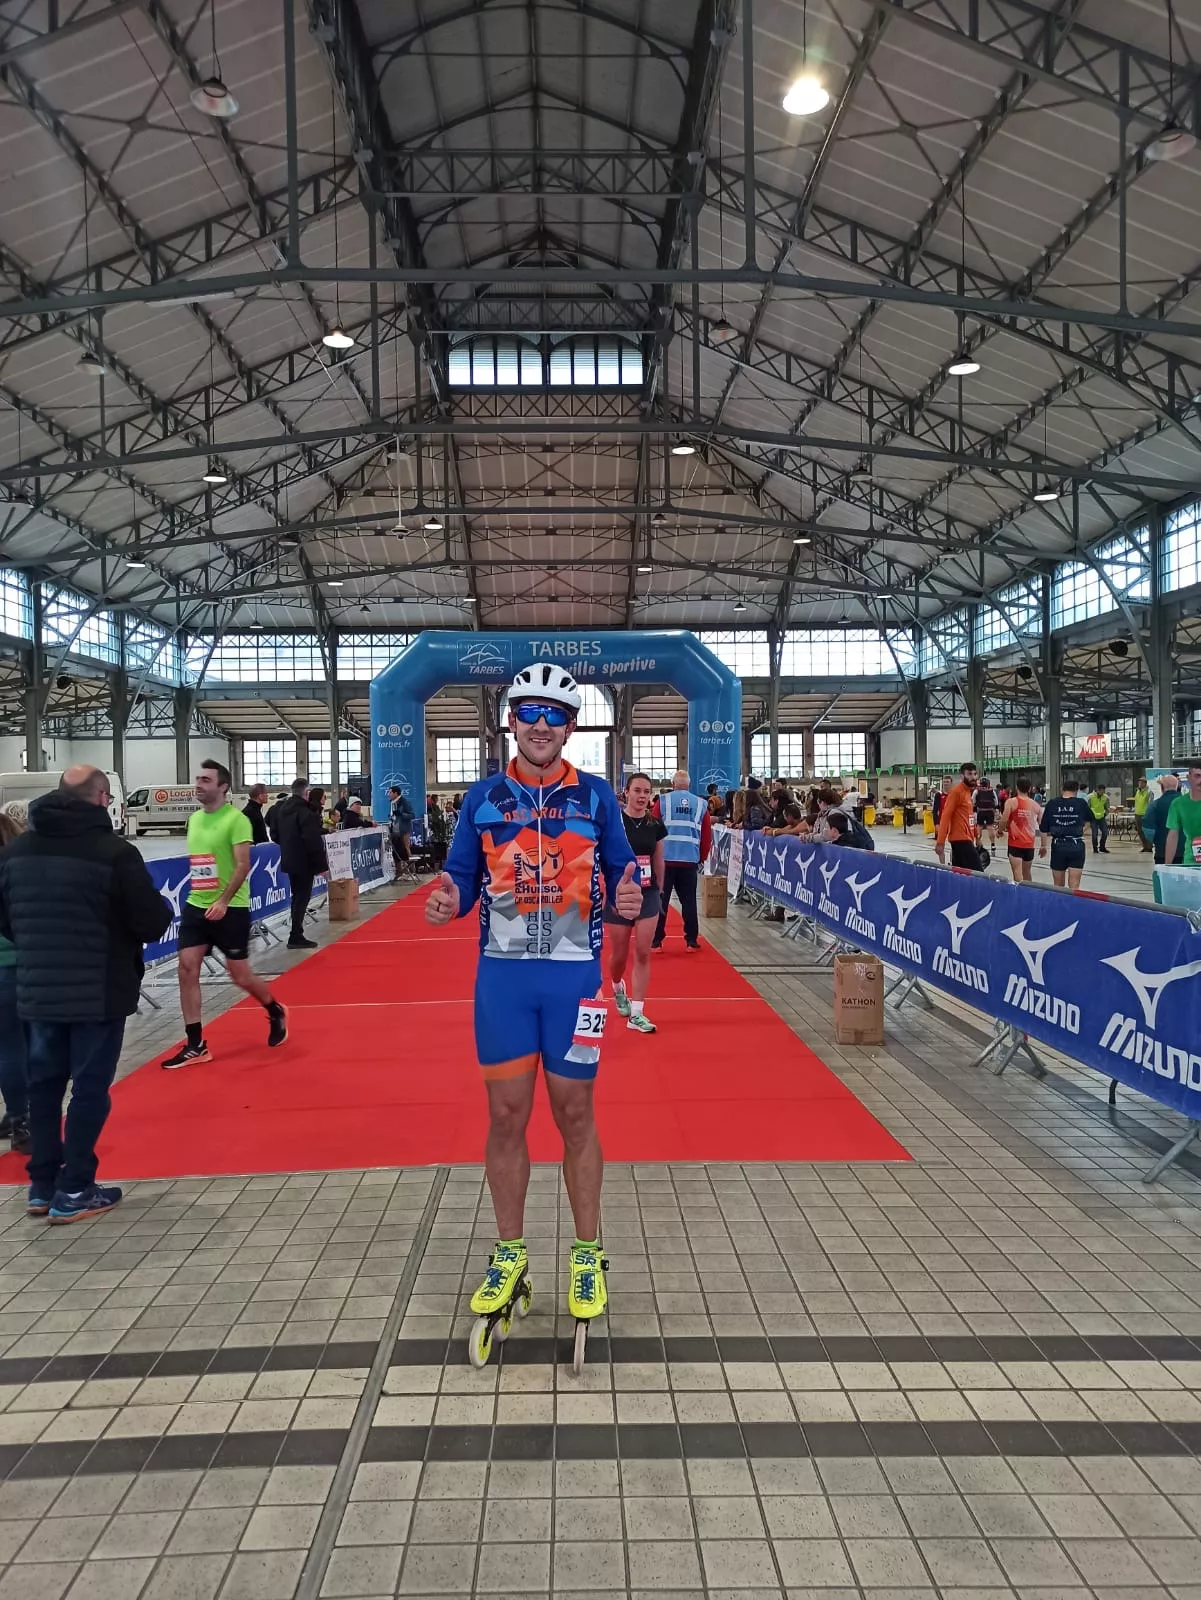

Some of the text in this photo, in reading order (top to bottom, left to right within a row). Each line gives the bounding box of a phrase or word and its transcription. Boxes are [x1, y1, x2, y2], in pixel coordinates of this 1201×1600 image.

[528, 641, 602, 657] TARBES
[469, 665, 505, 675] TARBES
[602, 656, 656, 677] sportive
[845, 906, 877, 941] MIZUNO
[882, 924, 923, 965] MIZUNO
[932, 946, 989, 994] MIZUNO
[842, 997, 876, 1006] KATHON
[1003, 974, 1080, 1035] MIZUNO
[1099, 1012, 1201, 1092] MIZUNO
[495, 1252, 517, 1263] SR
[574, 1254, 597, 1266] SR
